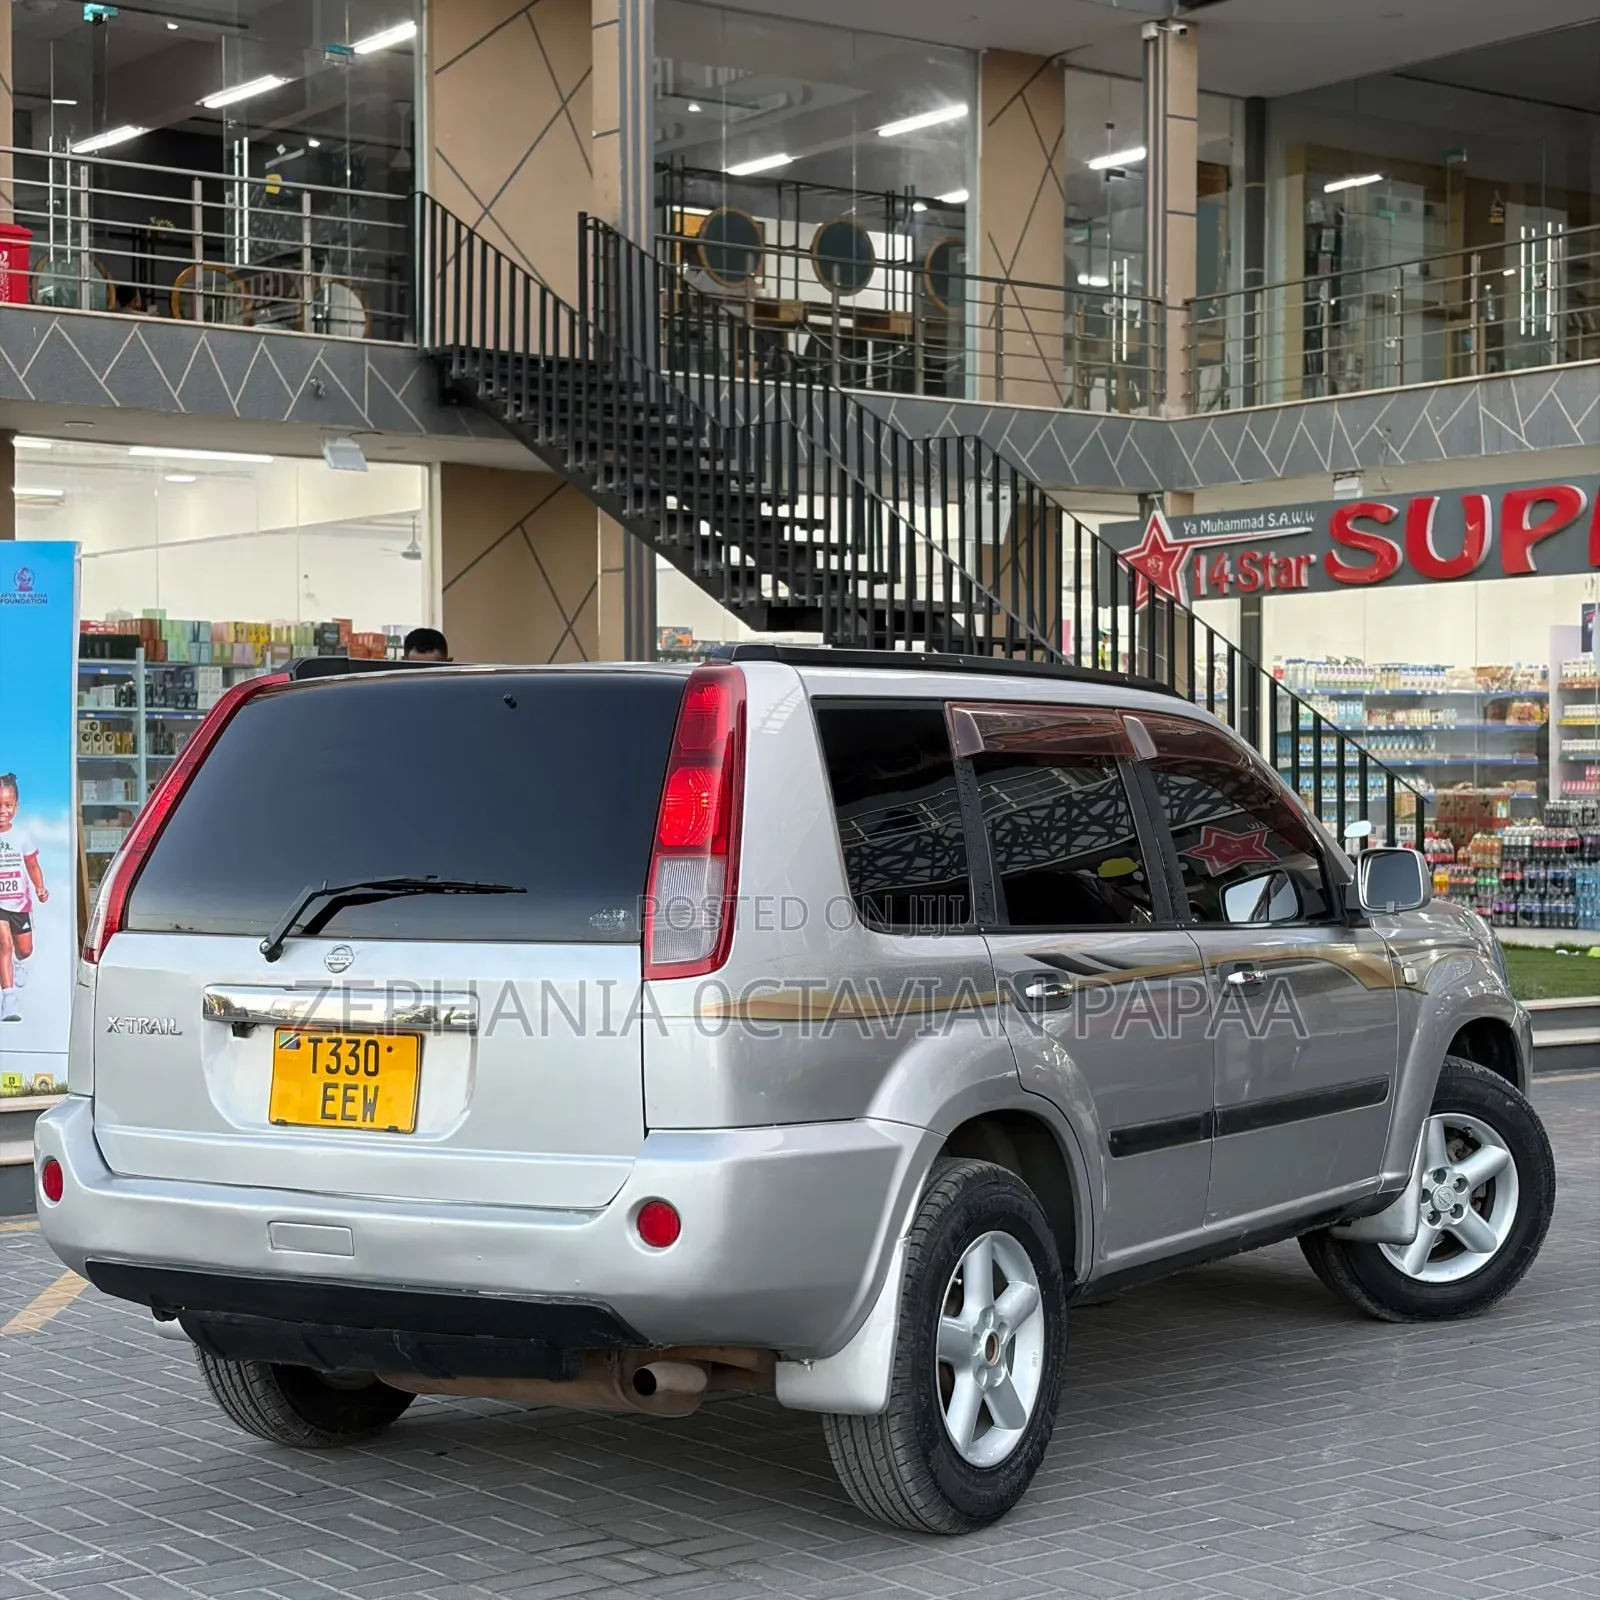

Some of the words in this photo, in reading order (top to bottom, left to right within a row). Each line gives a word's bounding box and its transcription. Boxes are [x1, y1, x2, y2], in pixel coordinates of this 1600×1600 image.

[1183, 521, 1197, 536] Ya
[1200, 514, 1264, 534] Muhammad
[1323, 484, 1600, 584] SUP
[106, 1016, 183, 1035] X-TRAIL
[307, 1036, 380, 1077] T330
[320, 1081, 380, 1123] EEW
